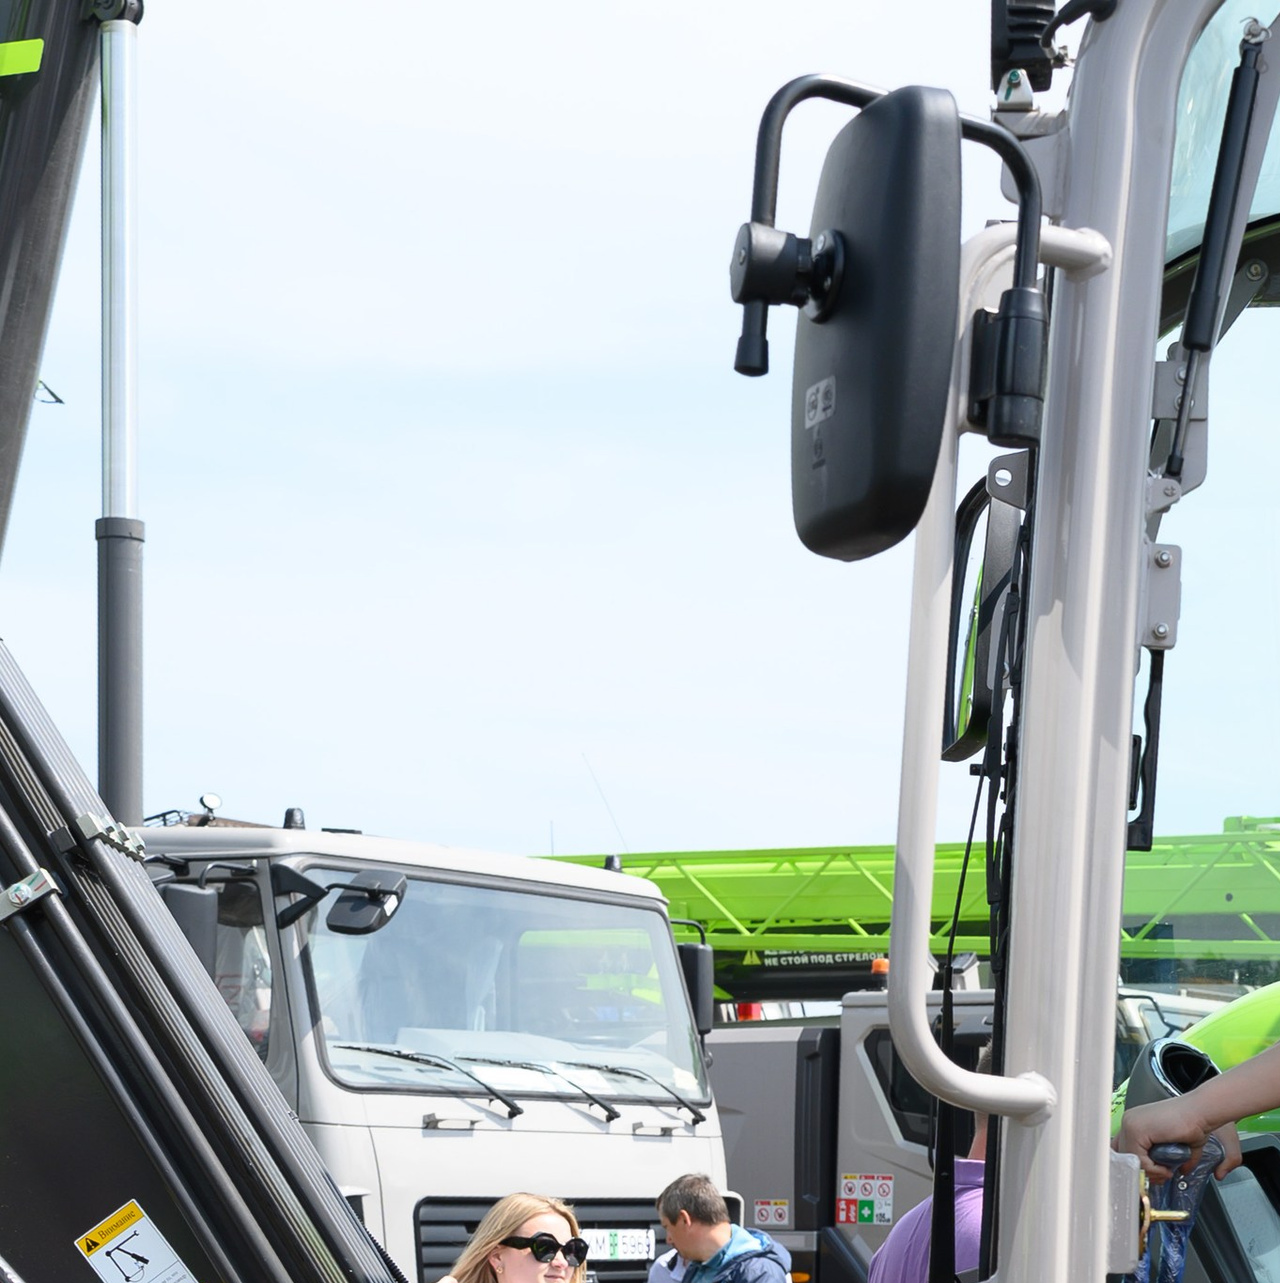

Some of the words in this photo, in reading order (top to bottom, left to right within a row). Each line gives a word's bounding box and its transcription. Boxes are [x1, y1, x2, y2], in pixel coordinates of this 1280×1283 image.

[764, 958, 779, 967] НЕ
[780, 956, 809, 966] СТОЙ
[810, 955, 834, 965] ПОД
[97, 1209, 137, 1241] Внимание
